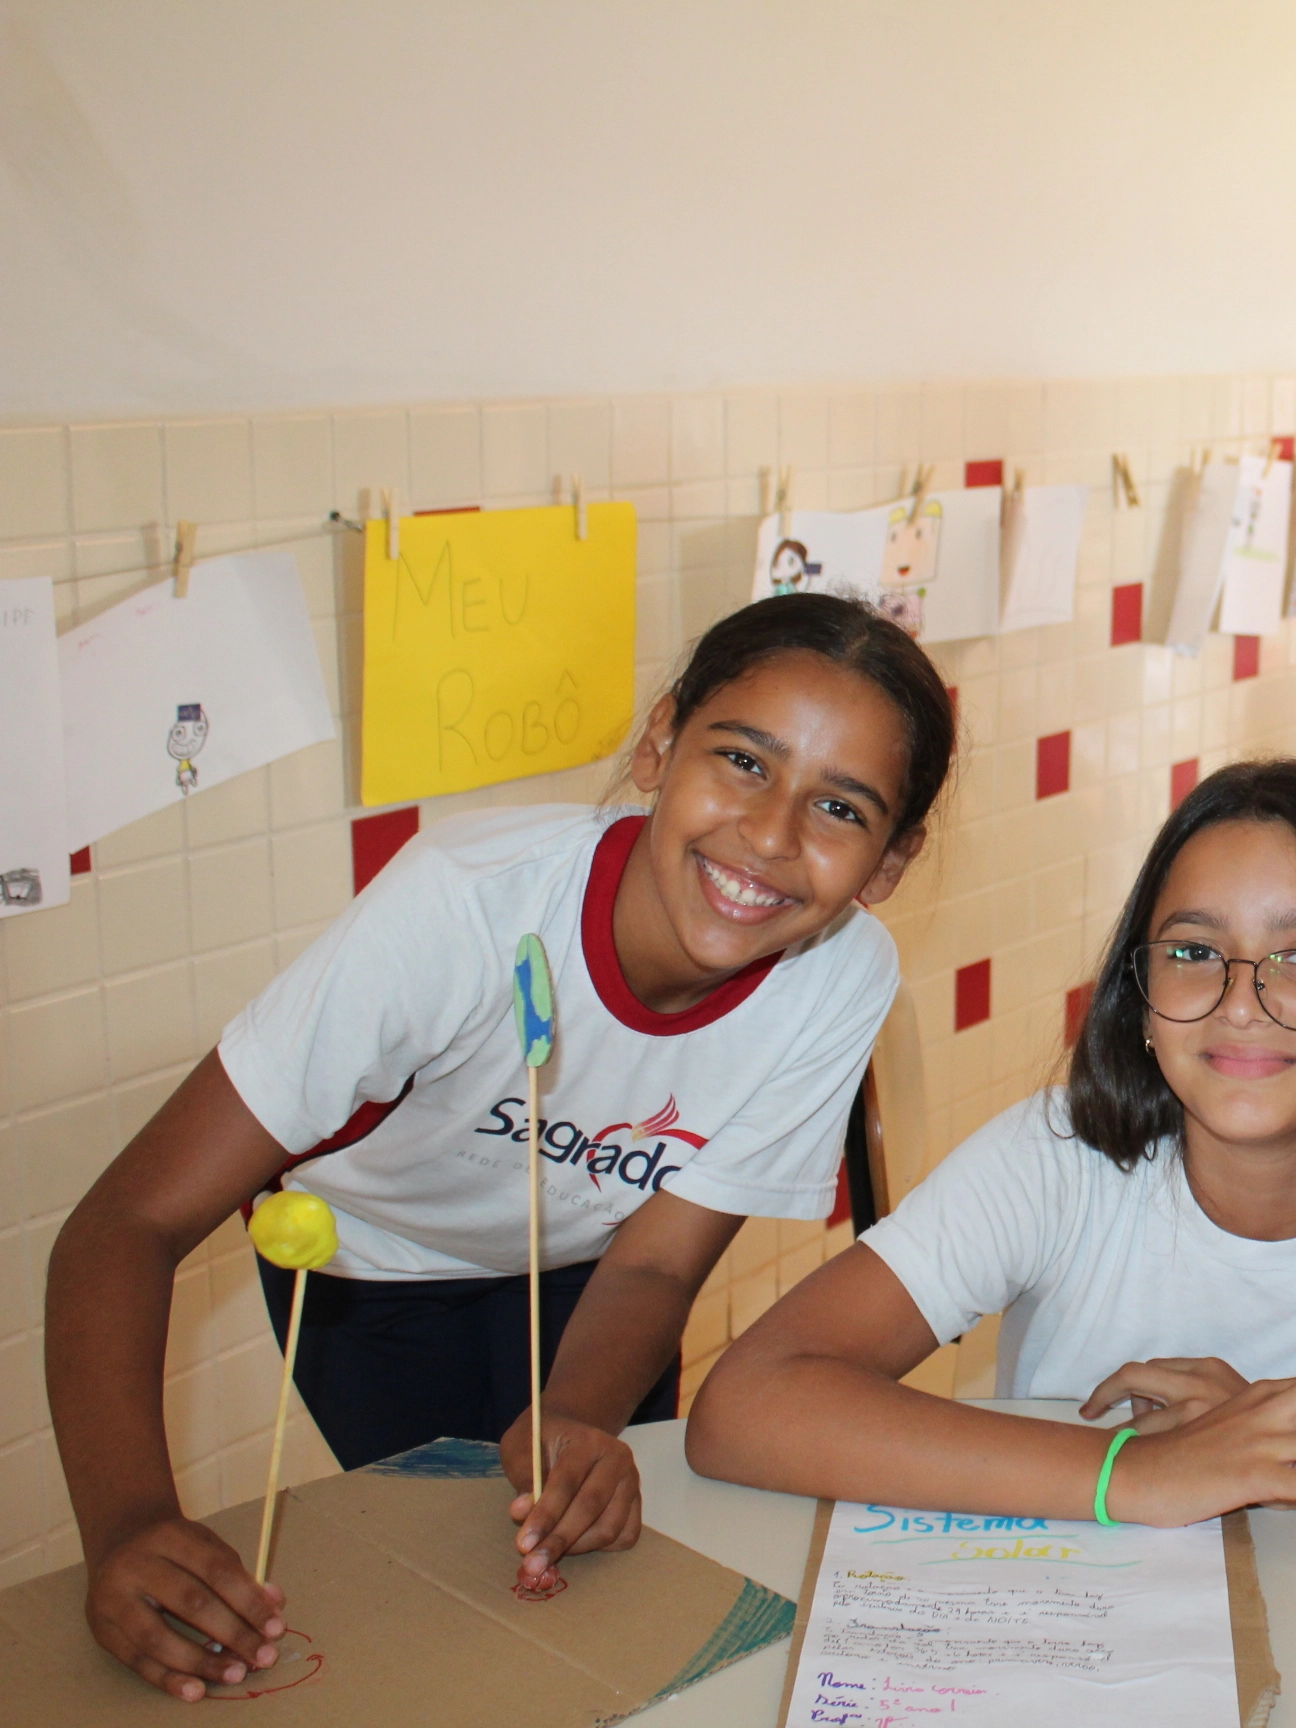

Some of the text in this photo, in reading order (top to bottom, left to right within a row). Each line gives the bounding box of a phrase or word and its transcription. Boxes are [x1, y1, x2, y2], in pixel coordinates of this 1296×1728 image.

[393, 541, 529, 643] MEU
[436, 667, 580, 774] ROBÔ
[456, 1150, 501, 1168] REDE
[540, 1177, 625, 1221] EDUCAÇÃO
[854, 1504, 1049, 1533] Sistema
[952, 1539, 1080, 1560] Solar
